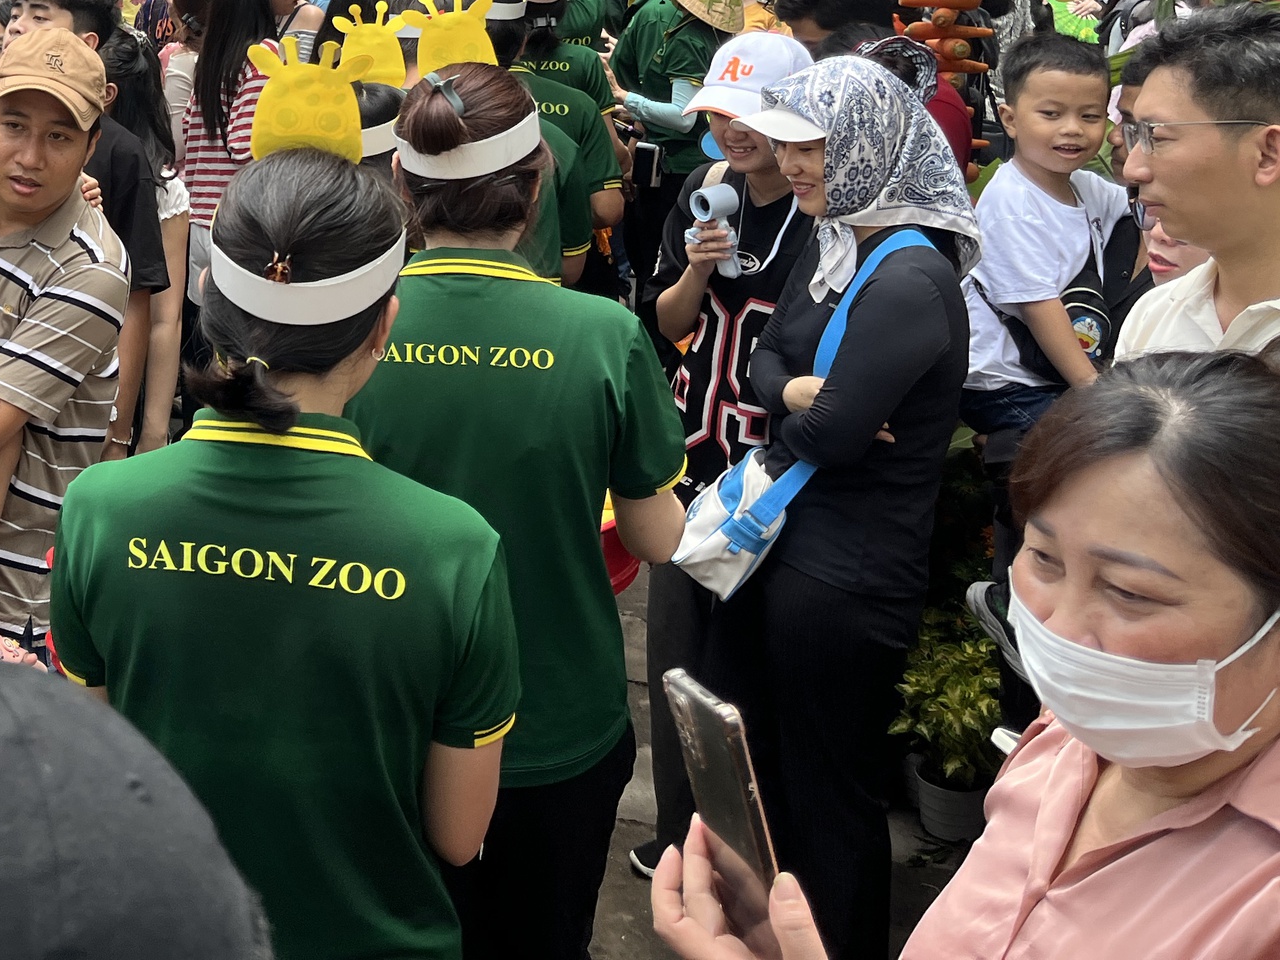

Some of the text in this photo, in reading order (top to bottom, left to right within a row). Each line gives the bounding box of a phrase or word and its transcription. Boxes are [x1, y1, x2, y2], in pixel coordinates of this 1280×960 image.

[540, 60, 570, 72] ZOO
[536, 101, 569, 116] OO
[383, 342, 555, 370] AIGON ZOO
[127, 537, 407, 600] SAIGON ZOO
